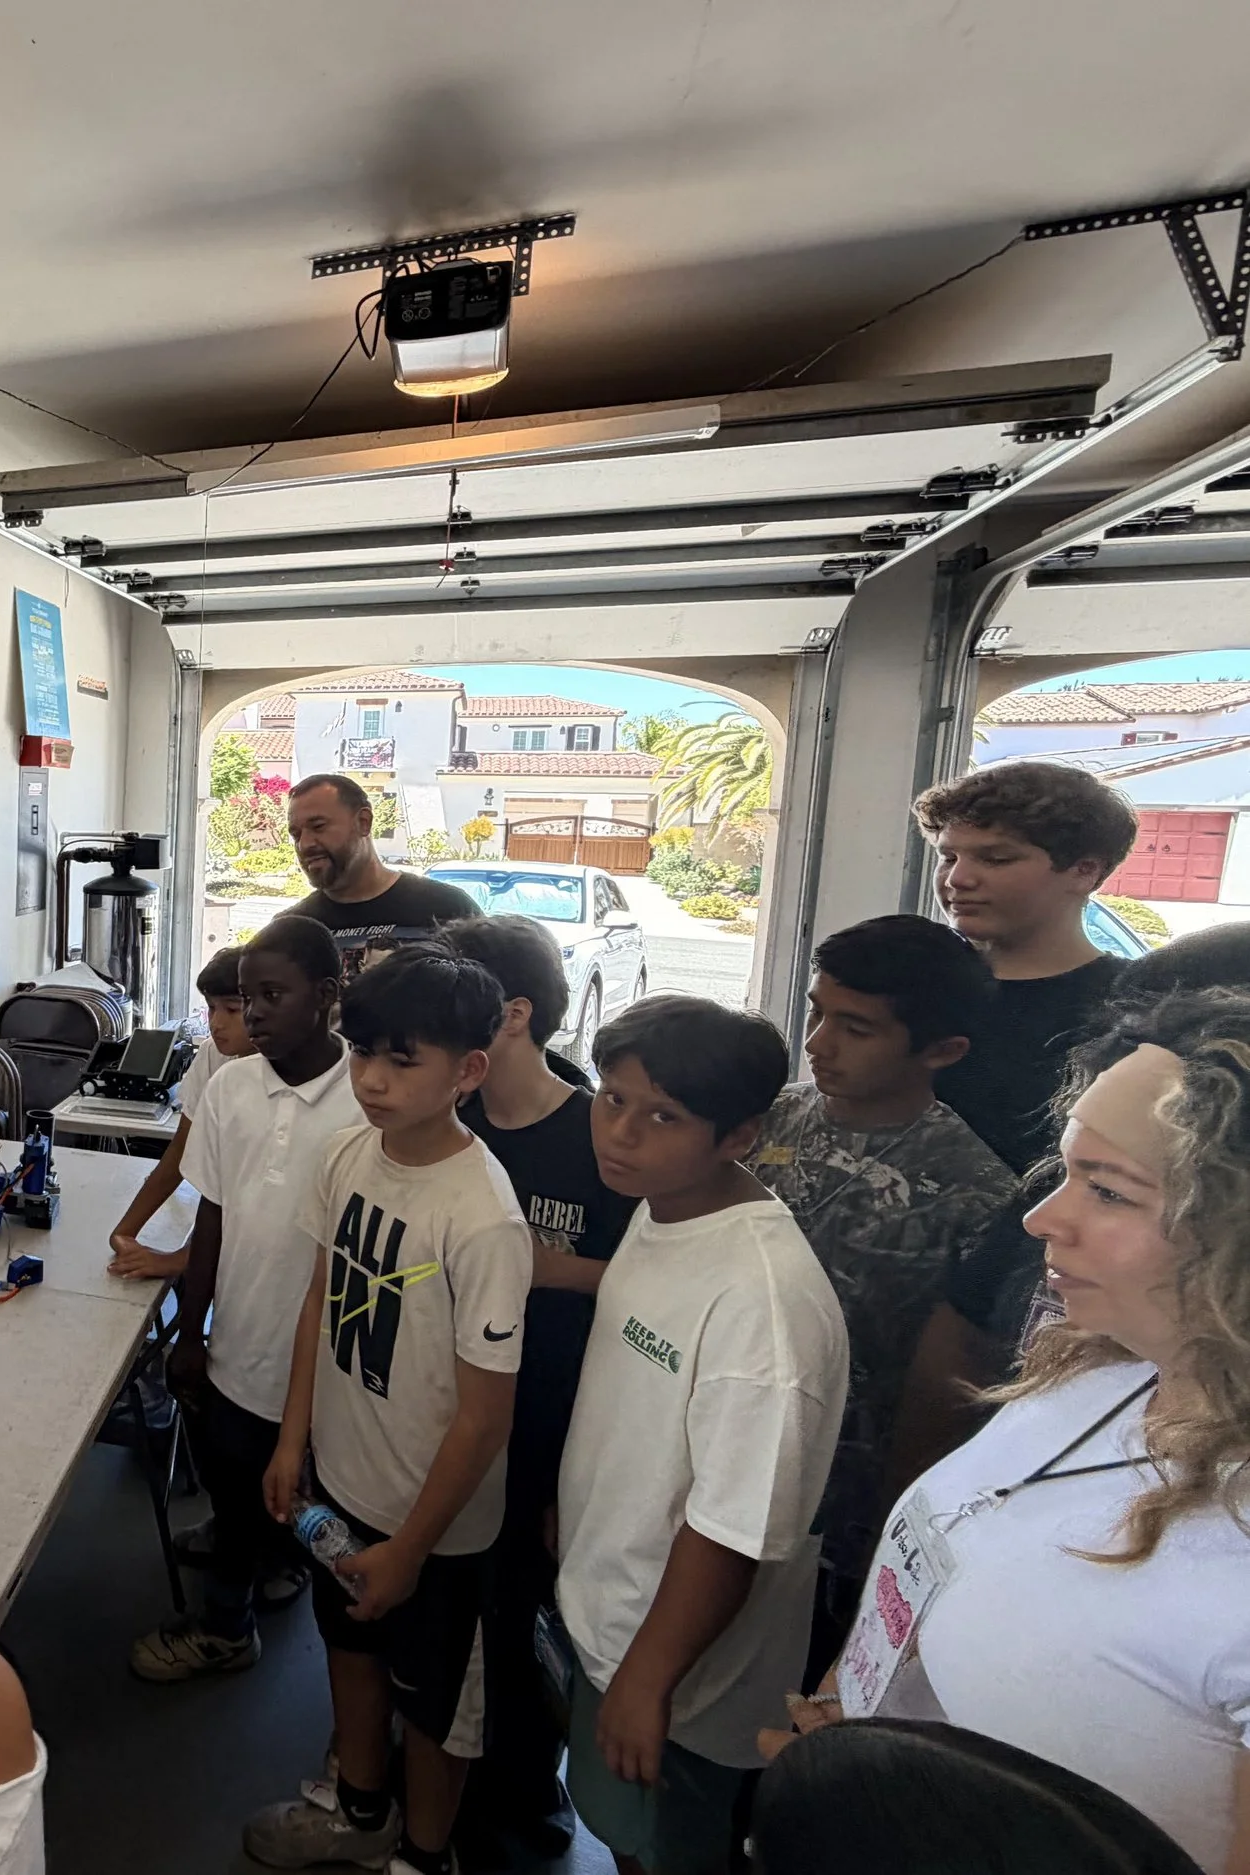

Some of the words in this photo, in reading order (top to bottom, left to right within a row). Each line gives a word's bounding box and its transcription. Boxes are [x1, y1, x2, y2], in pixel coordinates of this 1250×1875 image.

[334, 926, 367, 938] MONEY
[366, 924, 396, 935] FIGHT
[529, 1195, 586, 1233] REBEL
[622, 1325, 668, 1363] ROLLING
[627, 1316, 656, 1341] KEEP
[659, 1339, 674, 1353] IT
